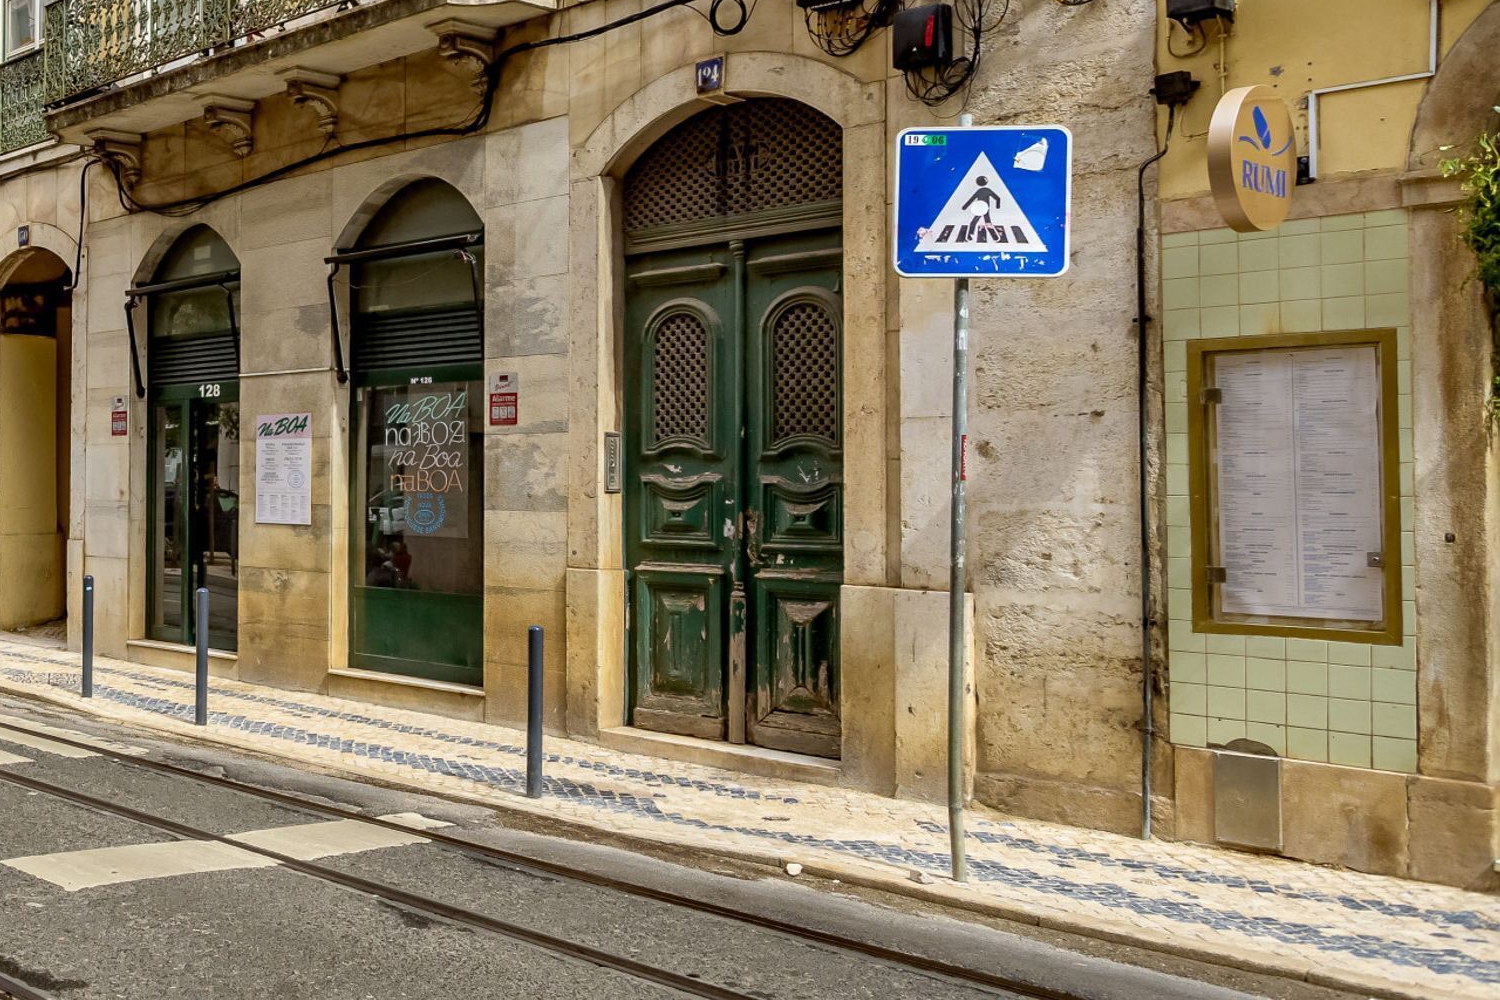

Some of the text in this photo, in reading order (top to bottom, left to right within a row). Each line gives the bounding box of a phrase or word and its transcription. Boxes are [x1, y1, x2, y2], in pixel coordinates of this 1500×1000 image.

[1242, 160, 1286, 199] RUMI
[420, 376, 433, 384] 126
[198, 384, 221, 398] 128
[492, 394, 516, 402] Alarme
